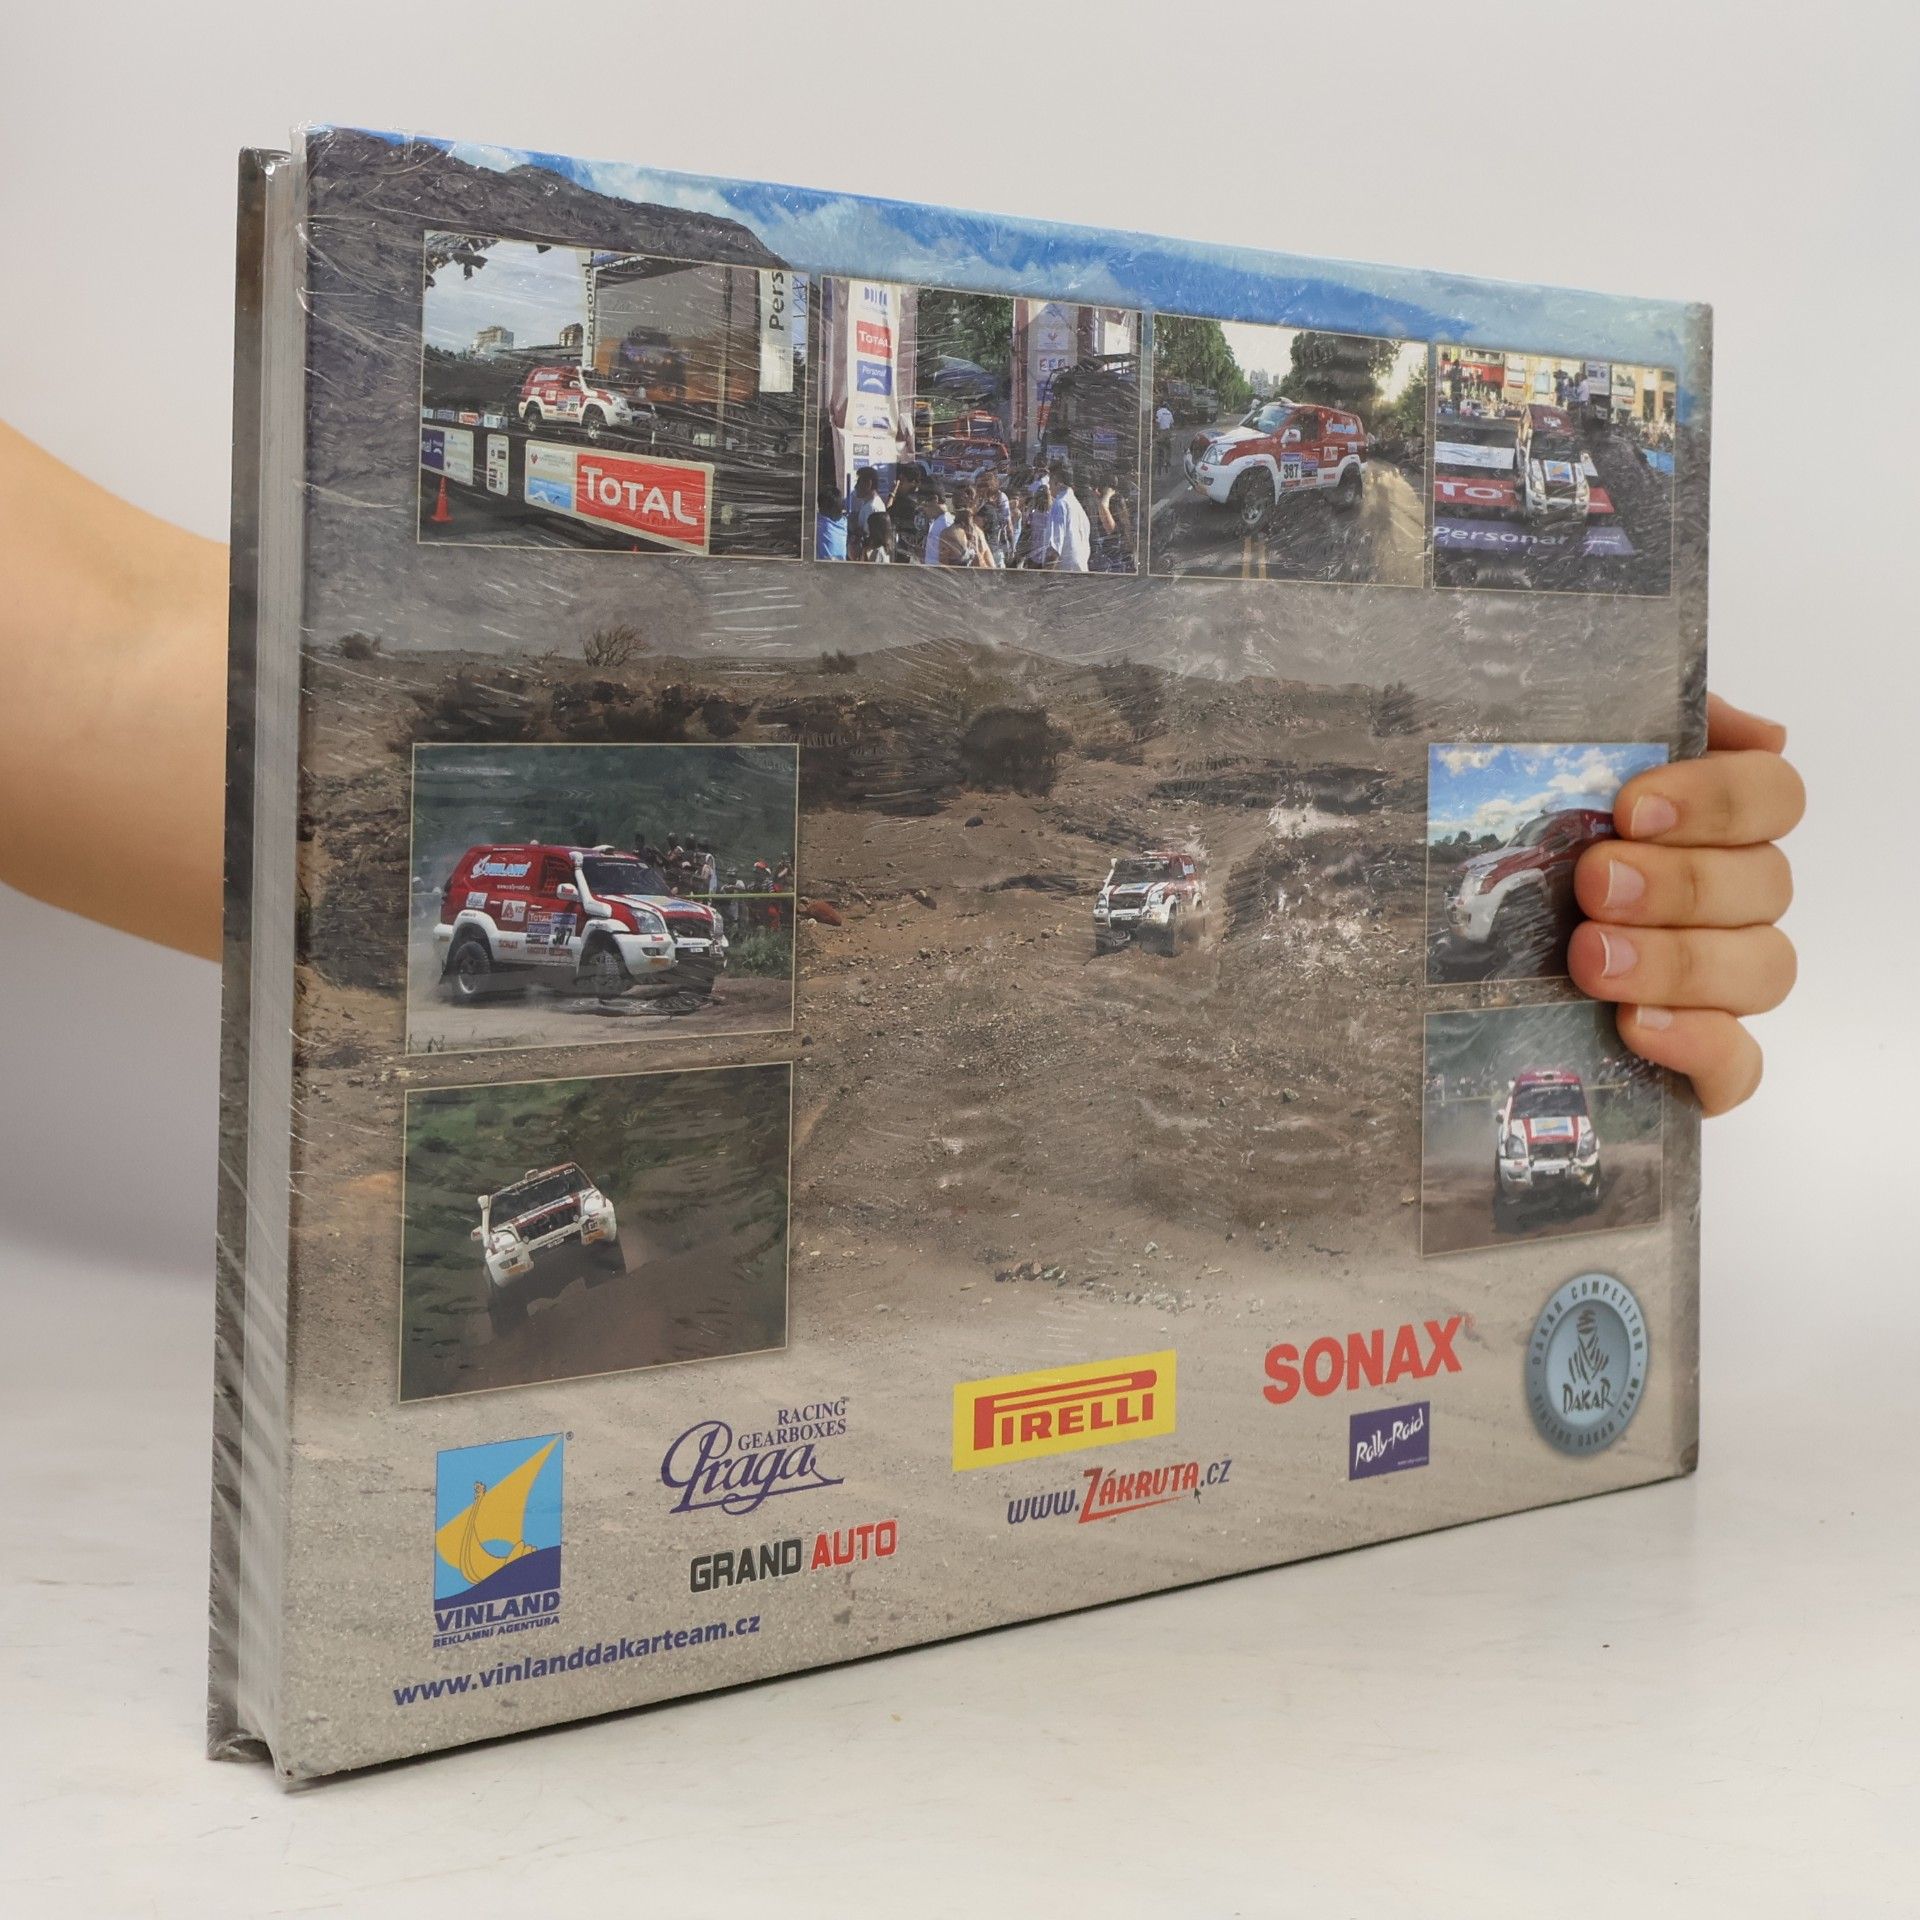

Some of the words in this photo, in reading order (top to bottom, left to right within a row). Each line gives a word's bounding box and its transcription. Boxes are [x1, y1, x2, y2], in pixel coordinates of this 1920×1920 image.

[859, 330, 891, 348] TOTAL
[581, 466, 698, 527] TOTAL
[1283, 464, 1300, 479] 387
[1263, 1315, 1462, 1406] SONAX
[777, 1399, 847, 1427] RACING
[973, 1368, 1158, 1452] PIRELLI
[1562, 1377, 1616, 1414] DAKAR
[737, 1418, 847, 1451] GEARBOXES
[1354, 1407, 1424, 1471] Rally-Raid
[660, 1419, 845, 1516] Praga
[689, 1537, 803, 1594] GRAND
[810, 1519, 898, 1571] AUTO
[434, 1590, 561, 1633] VINLAND
[496, 1614, 560, 1636] AGENTURA
[392, 1614, 761, 1707] www.vinlanddakarteam.cz
